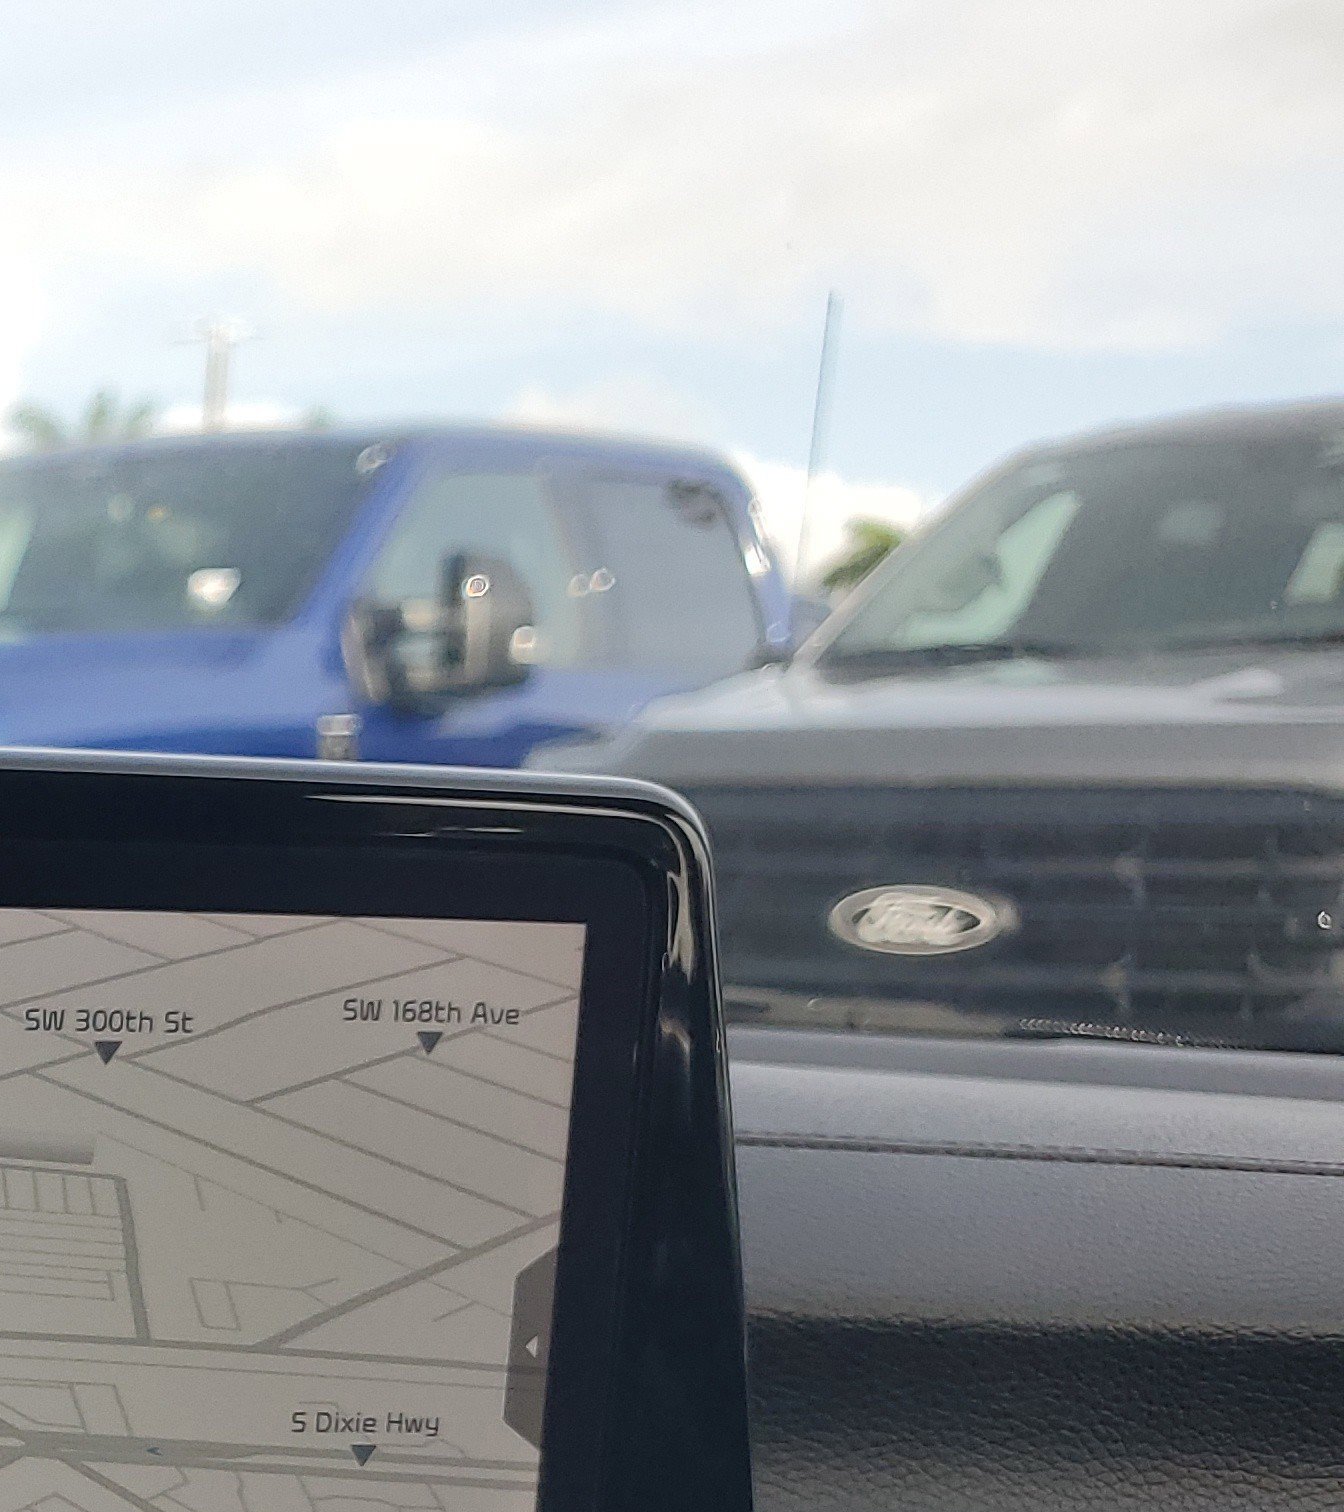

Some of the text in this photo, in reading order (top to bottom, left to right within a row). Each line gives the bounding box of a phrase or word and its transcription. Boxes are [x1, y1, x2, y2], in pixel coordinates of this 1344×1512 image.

[24, 1008, 193, 1033] SW 300th St
[342, 998, 520, 1026] SW 168th Ave
[291, 1411, 441, 1439] S Dixie Hwy
